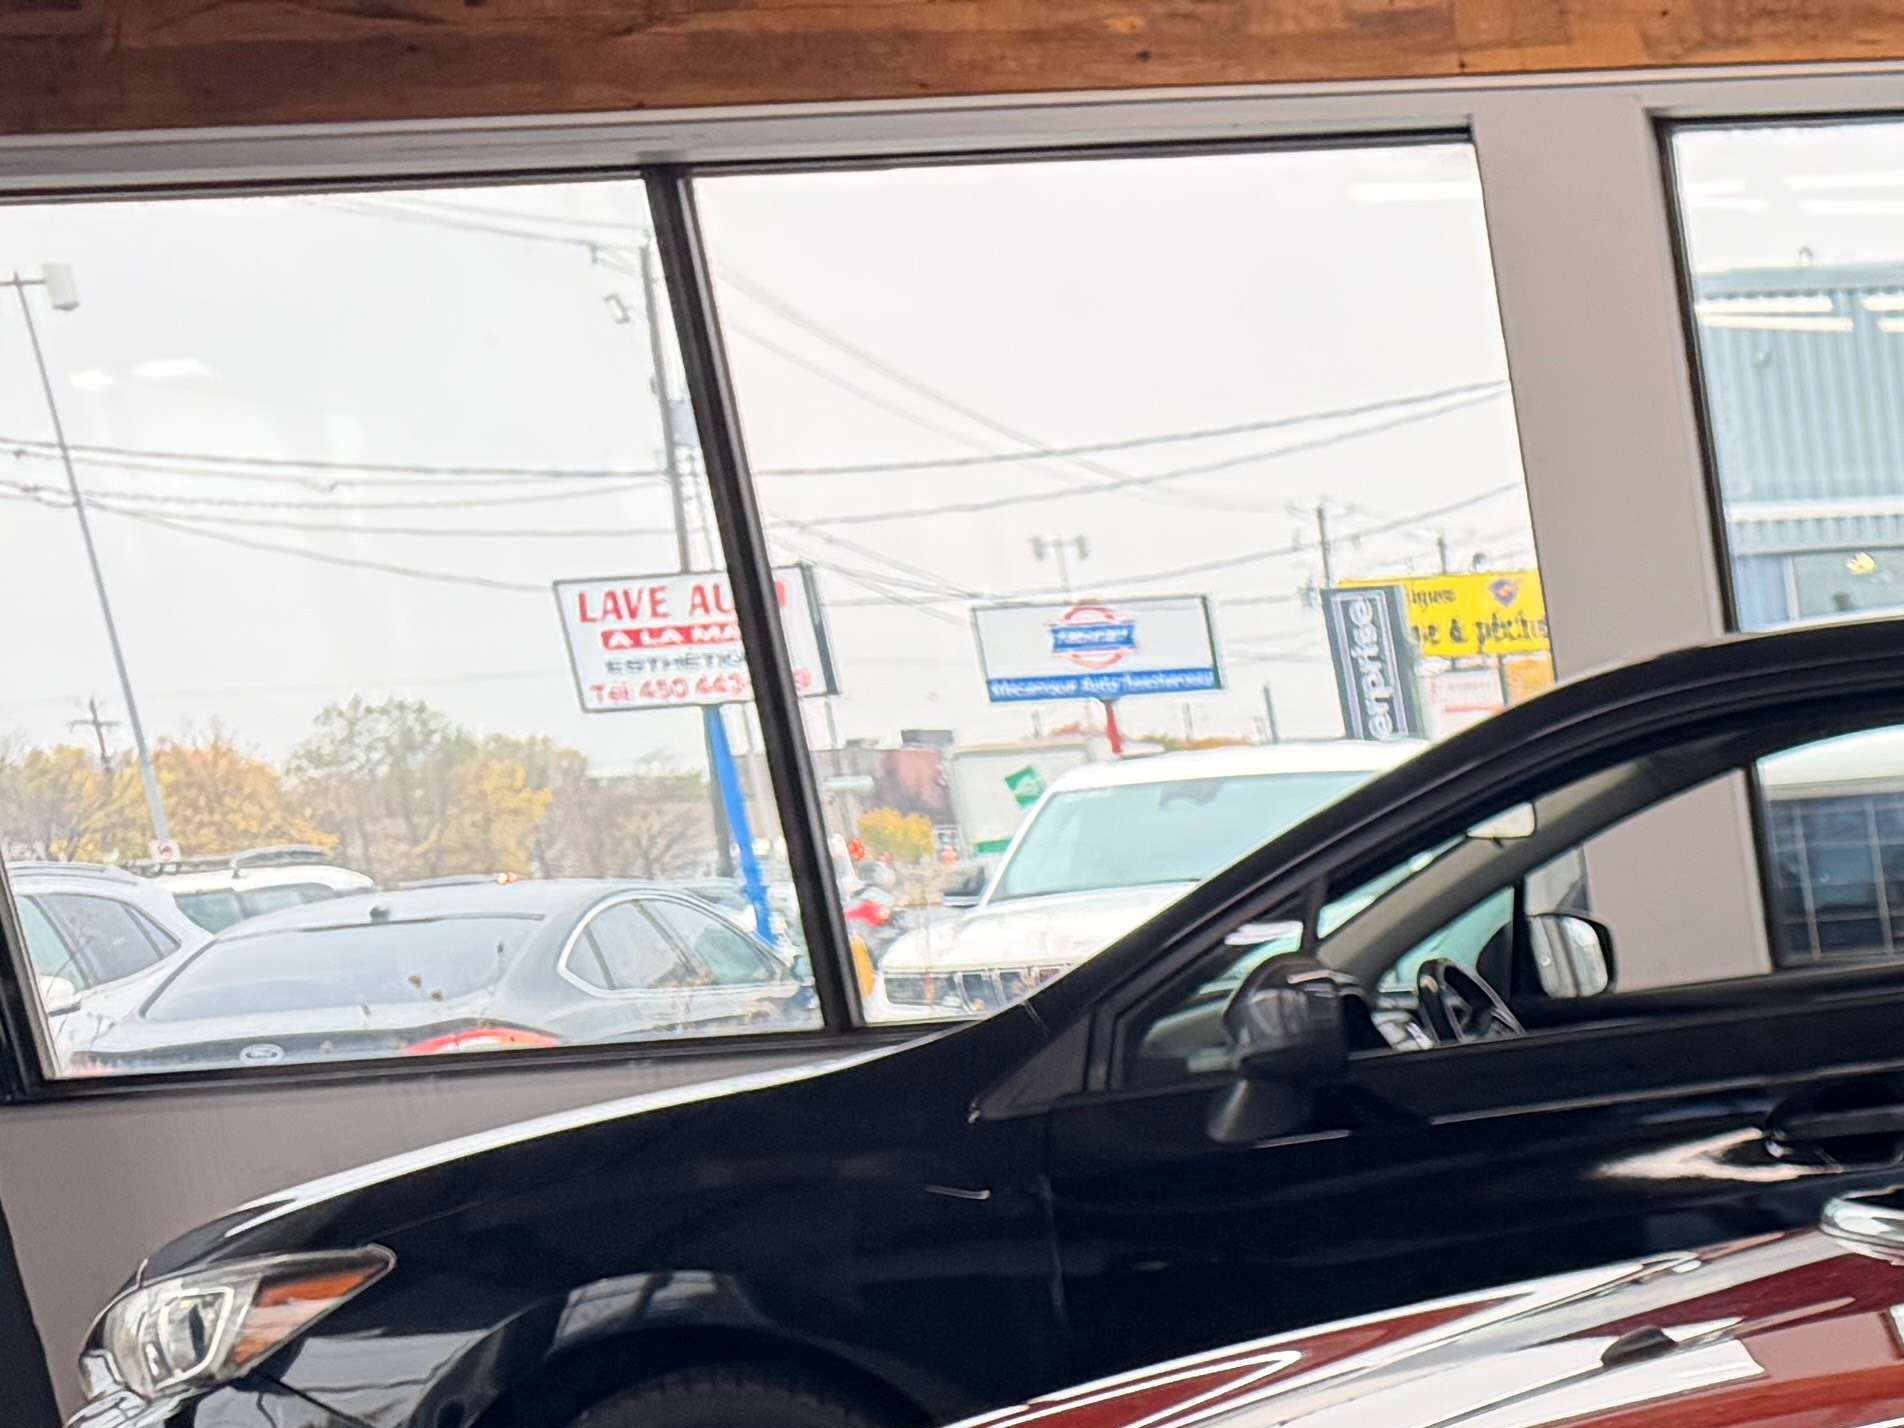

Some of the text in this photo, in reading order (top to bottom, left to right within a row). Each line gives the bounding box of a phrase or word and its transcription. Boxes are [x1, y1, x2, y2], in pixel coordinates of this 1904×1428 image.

[578, 586, 671, 623] LAVE
[640, 629, 684, 646] LA
[690, 624, 742, 642] MA
[1349, 598, 1394, 742] erprise
